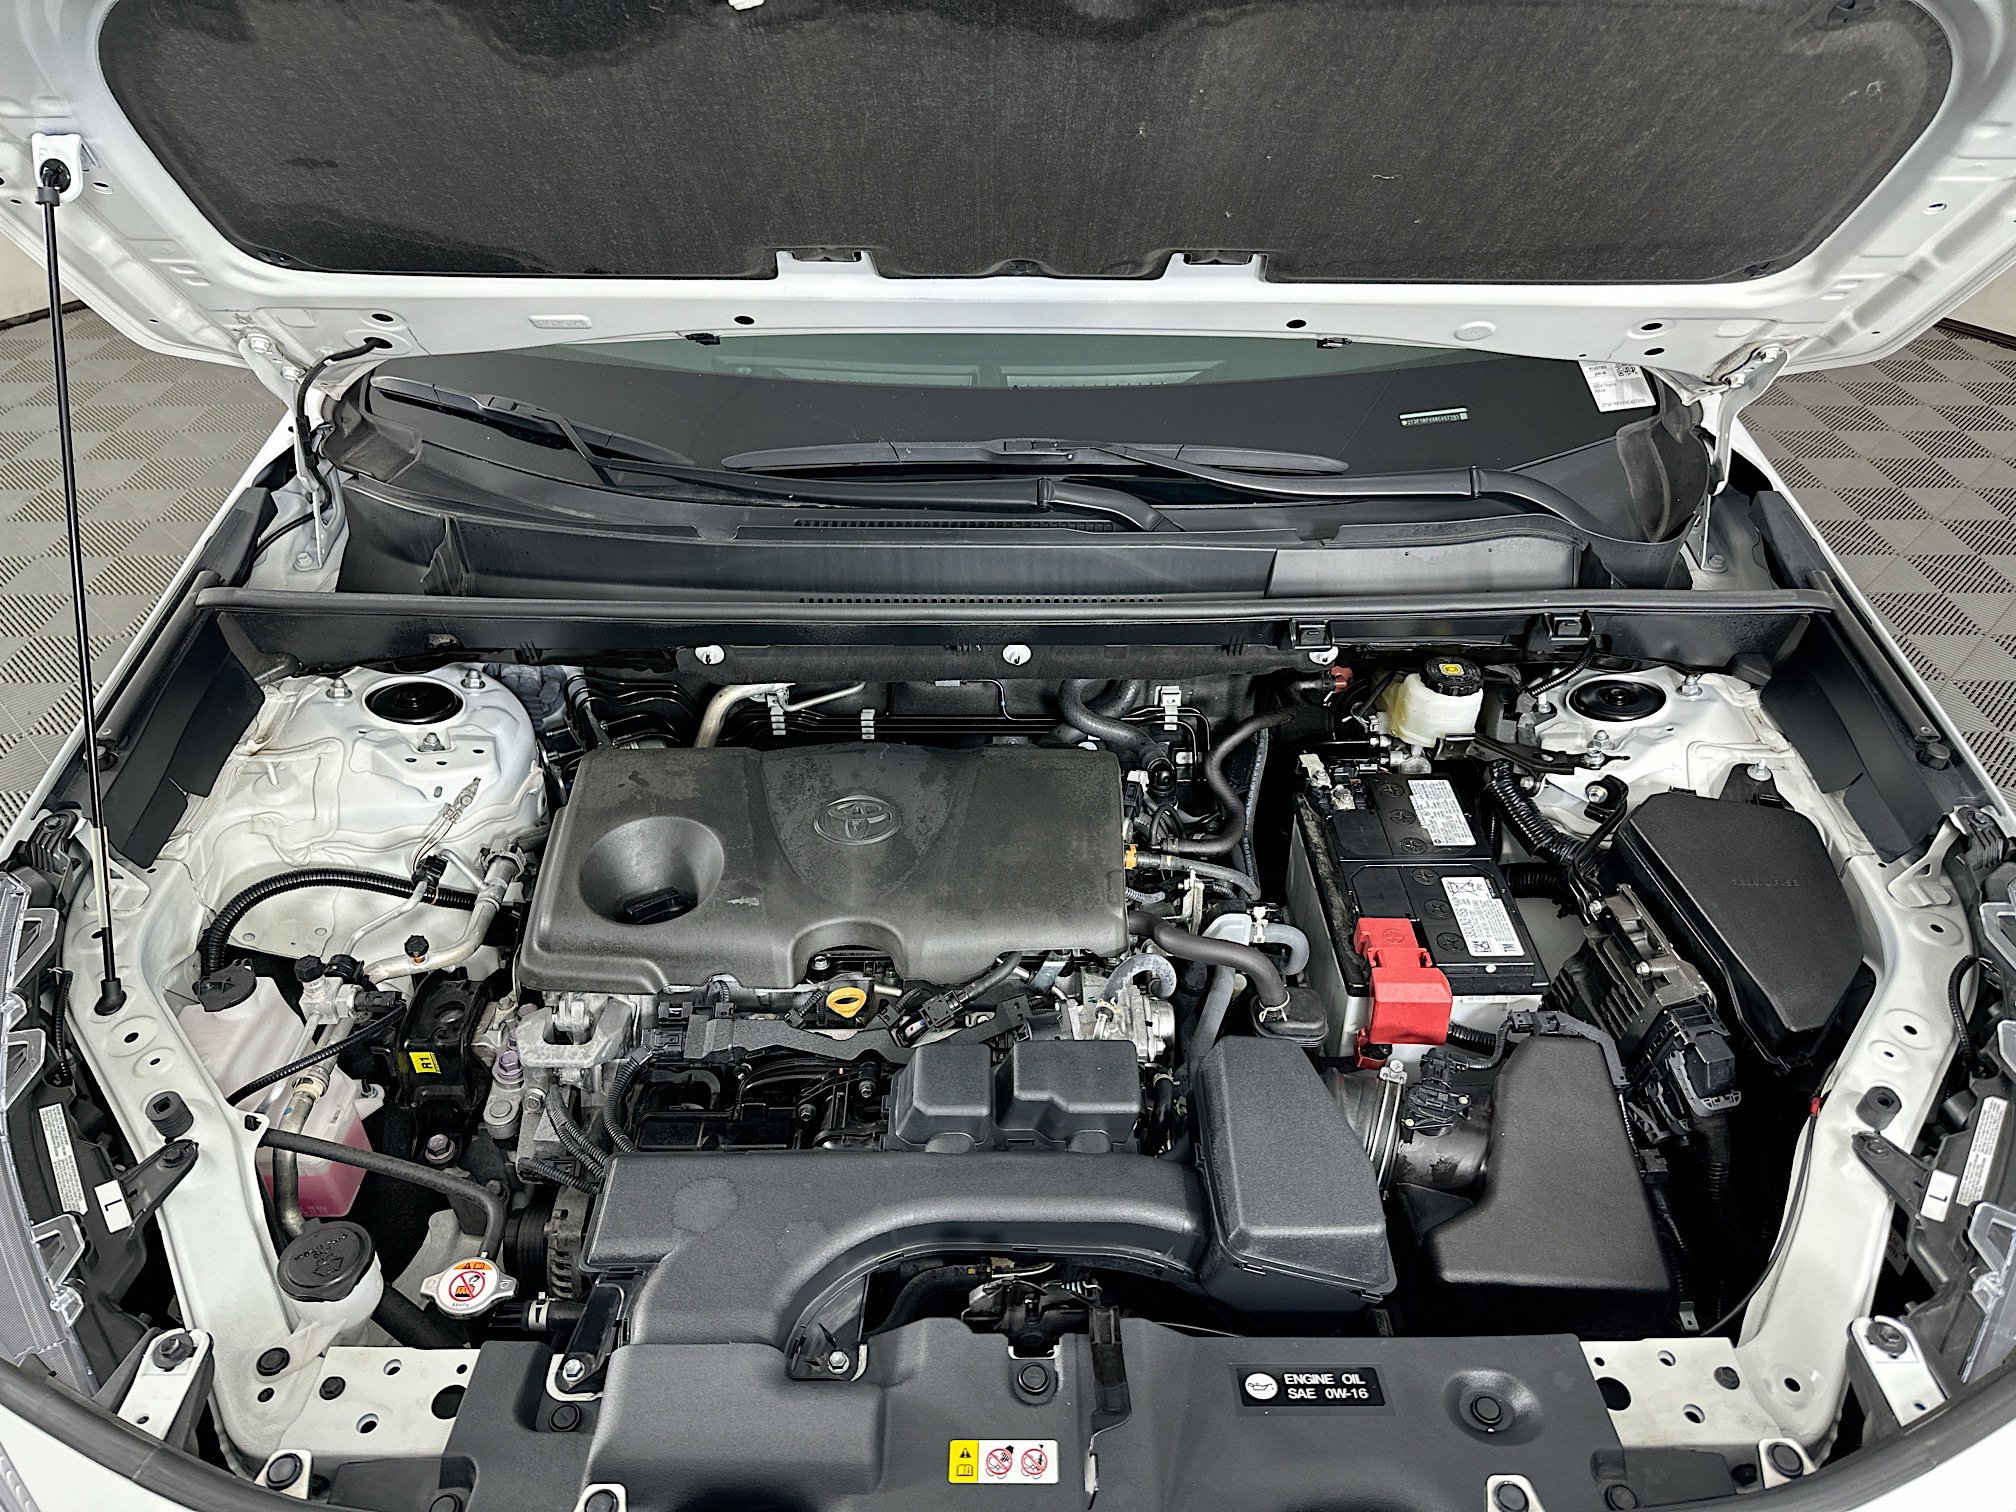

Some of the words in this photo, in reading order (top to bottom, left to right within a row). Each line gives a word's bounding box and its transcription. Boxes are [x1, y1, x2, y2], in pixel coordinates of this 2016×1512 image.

[1283, 1373, 1334, 1385] ENGINE
[1341, 1373, 1366, 1385] OIL
[1287, 1388, 1317, 1399] SAE
[1324, 1388, 1369, 1399] 0W-16
